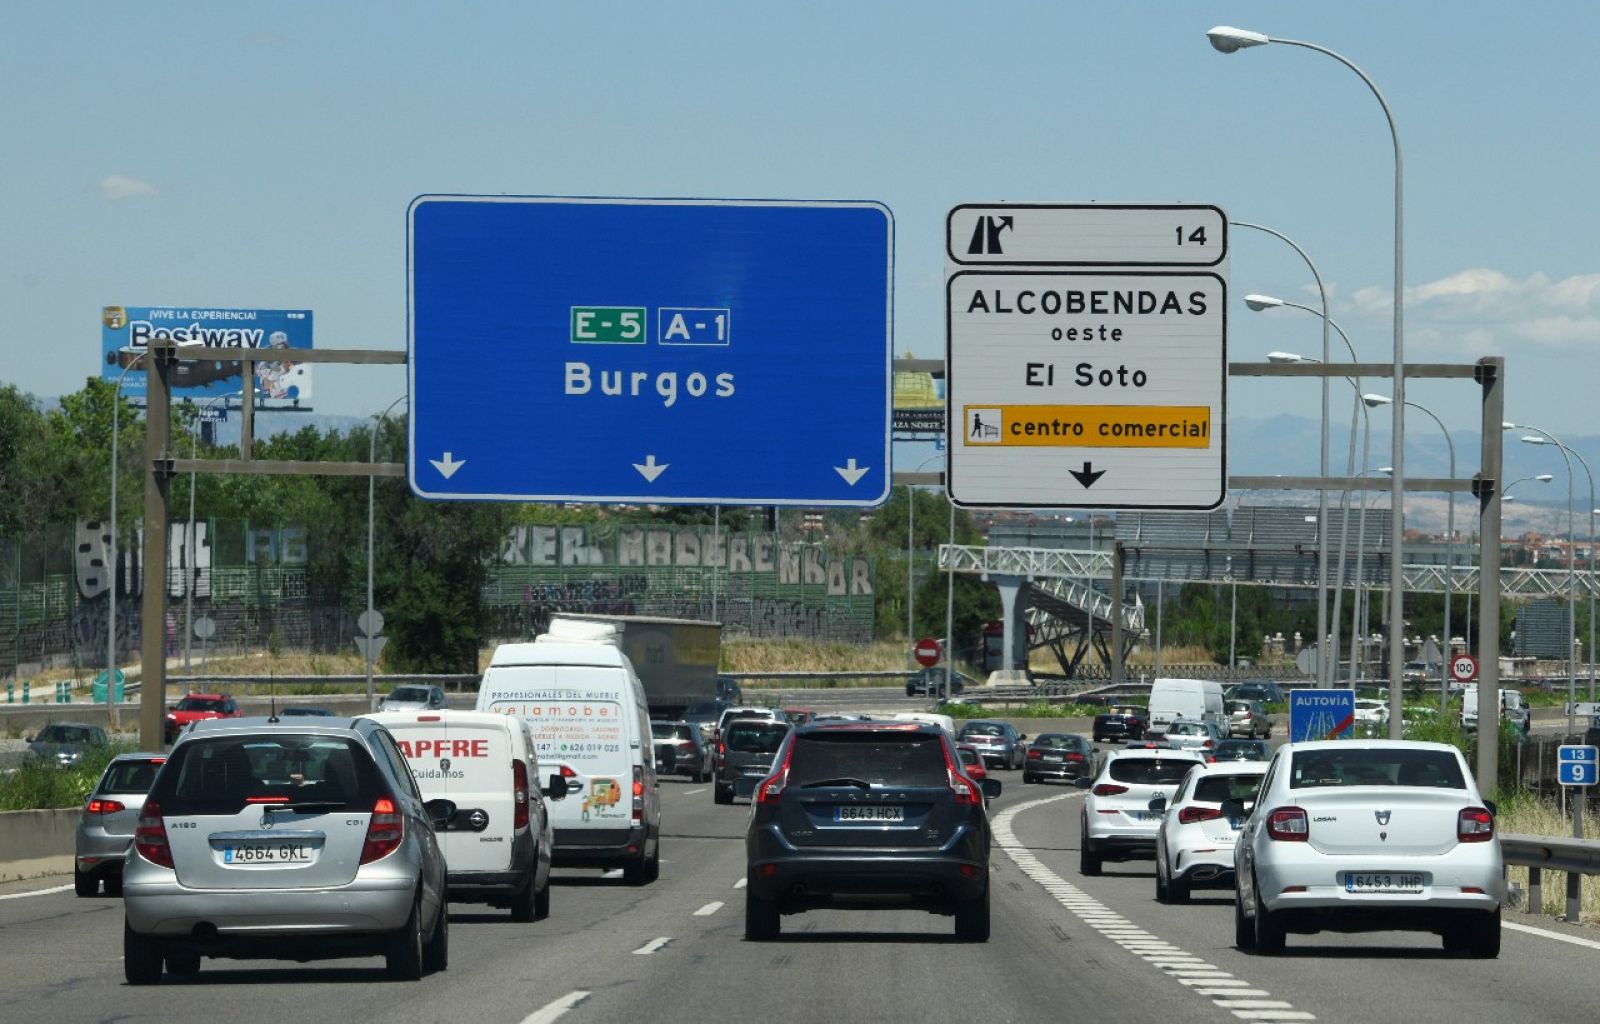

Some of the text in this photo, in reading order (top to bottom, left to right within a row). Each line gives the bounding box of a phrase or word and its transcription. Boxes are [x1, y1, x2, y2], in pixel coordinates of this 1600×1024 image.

[1175, 225, 1207, 246] 14
[966, 289, 1207, 316] ALCOBENDAS
[177, 310, 189, 320] LA
[191, 310, 257, 321] EXPERIENCIA!
[576, 312, 725, 341] E-5 A-1
[1051, 324, 1123, 342] oeste
[1025, 362, 1148, 388] El Soto
[564, 361, 736, 408] Burgos
[1010, 418, 1208, 438] centro comercial
[1455, 663, 1473, 674] 100
[491, 690, 620, 700] PROFESIONALES DEL MUEBLE
[396, 739, 489, 758] APFRE
[569, 743, 585, 752] 626
[587, 744, 602, 752] 019
[604, 744, 619, 752] 025
[1571, 749, 1586, 761] 13
[1571, 765, 1585, 782] 9
[841, 807, 901, 820] 6643 HCX
[234, 844, 308, 861] 4664 GKL
[1356, 875, 1392, 888] 6453
